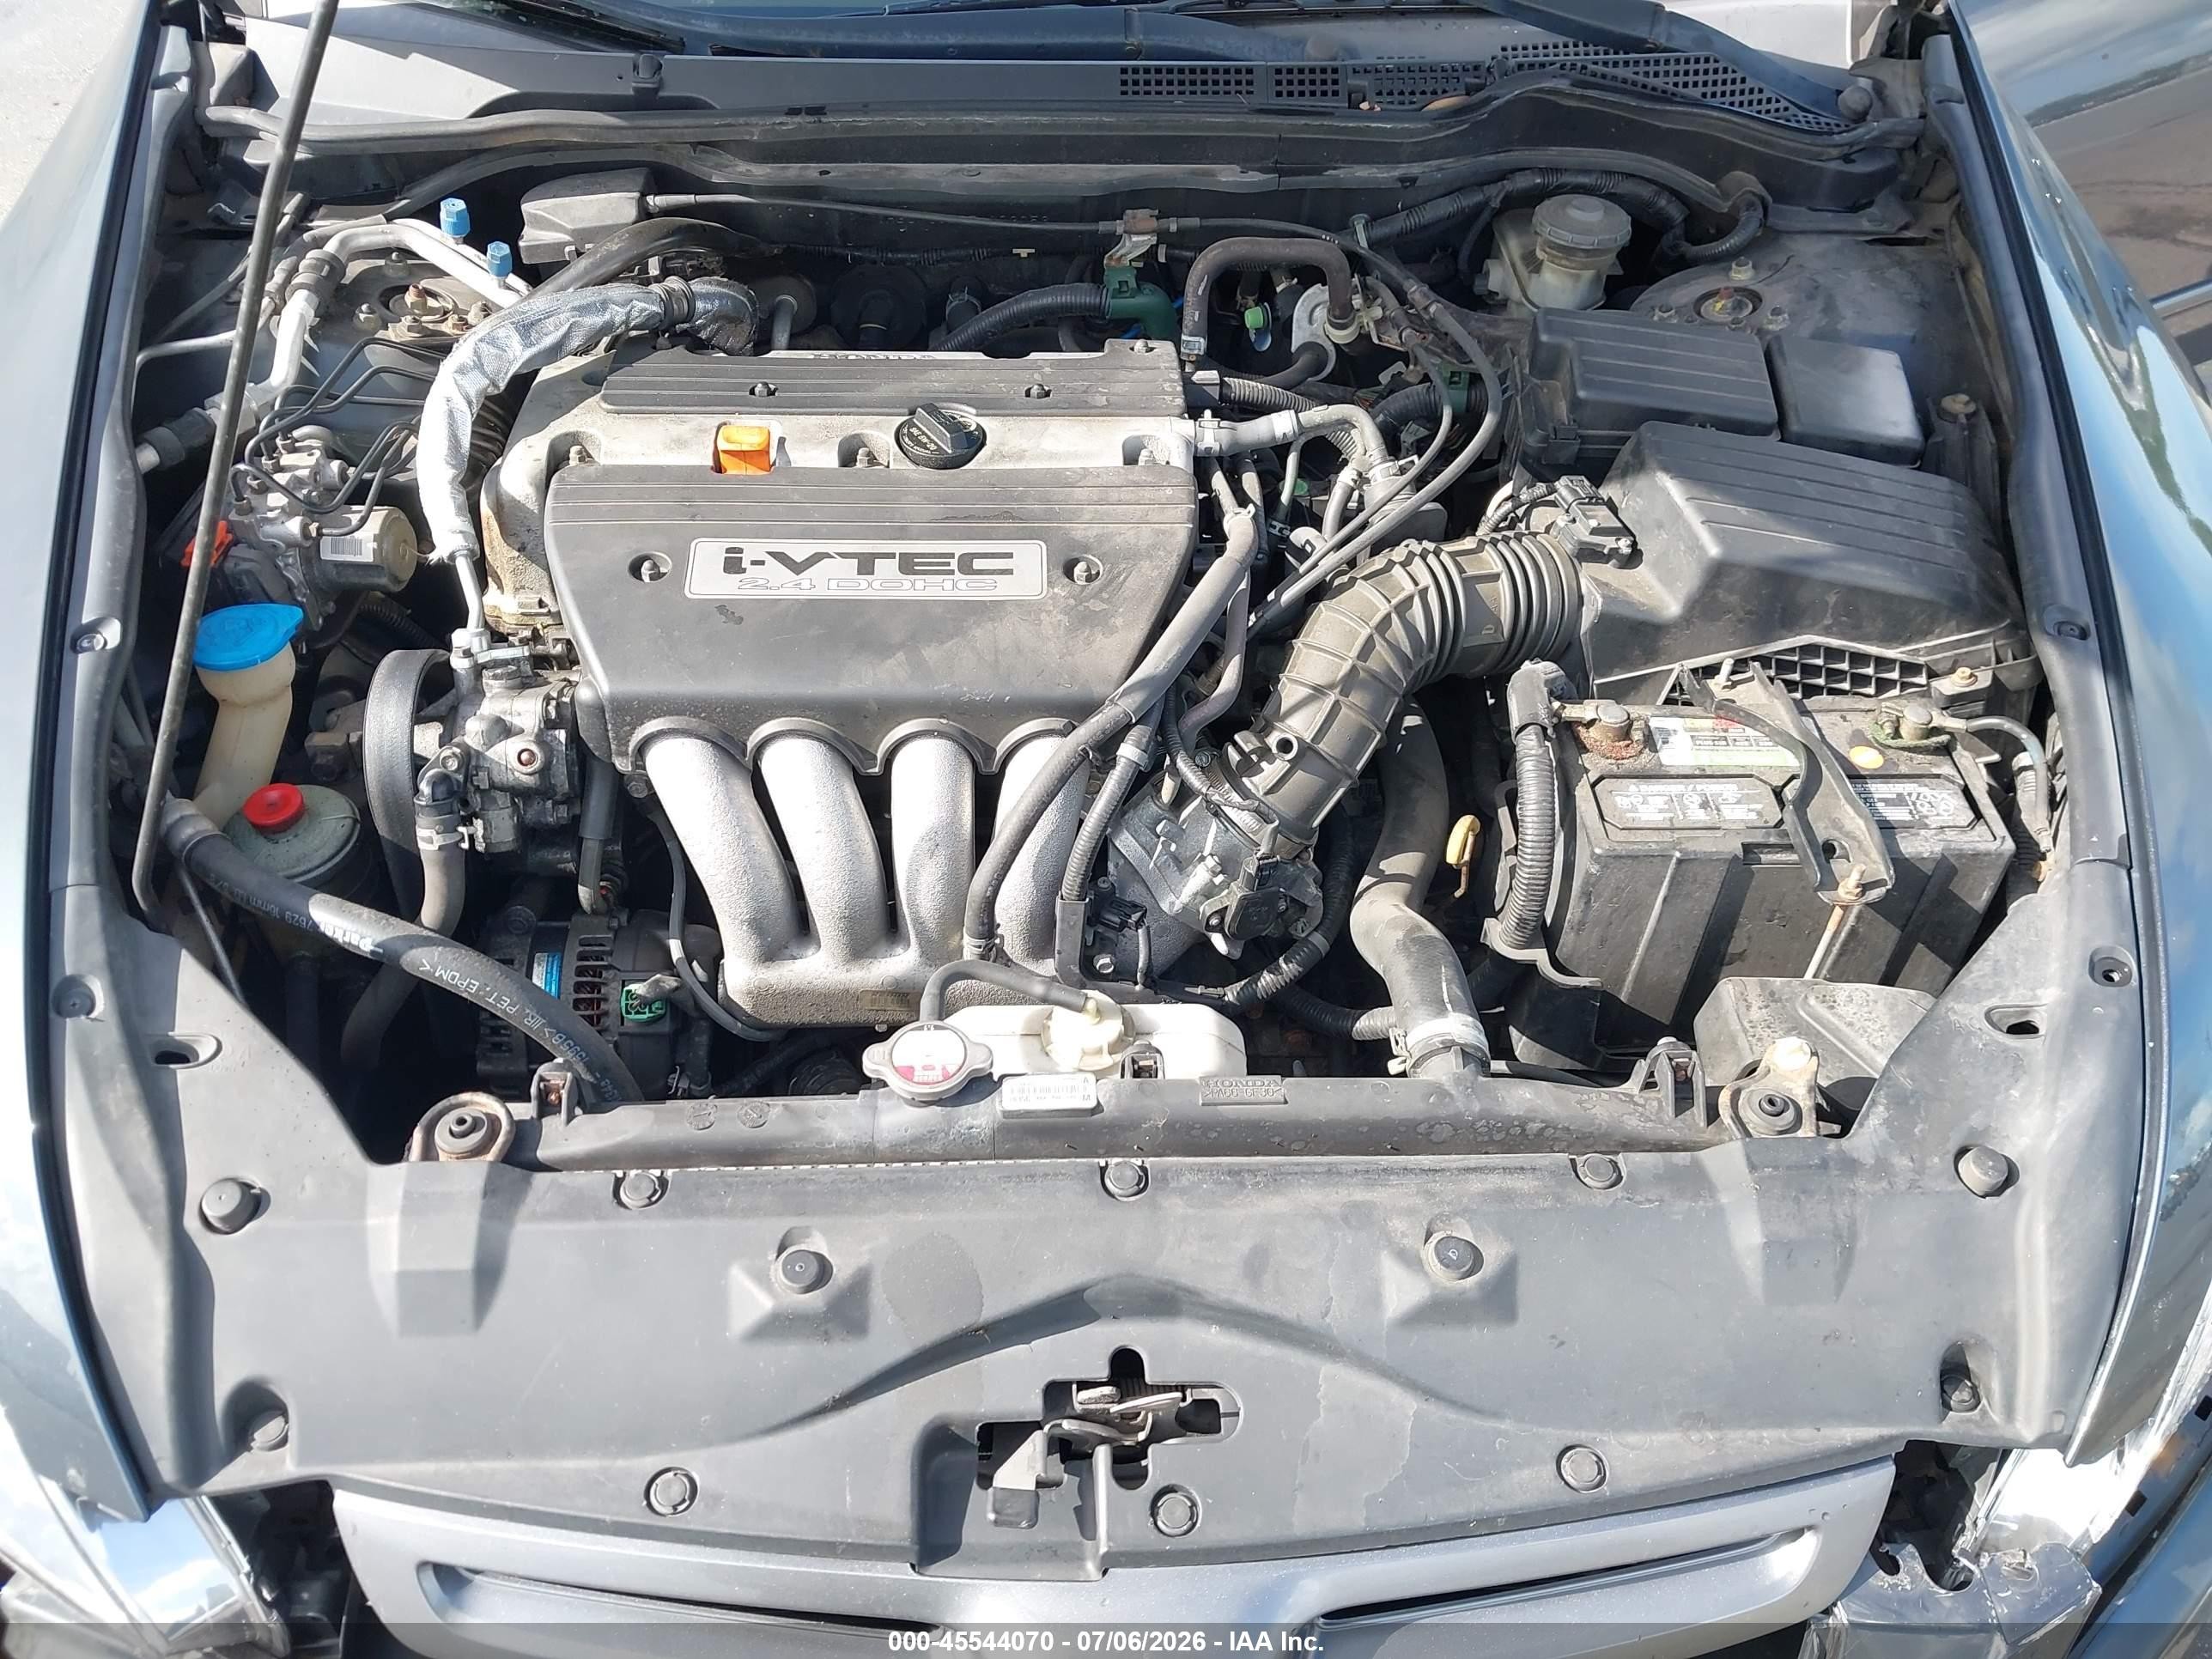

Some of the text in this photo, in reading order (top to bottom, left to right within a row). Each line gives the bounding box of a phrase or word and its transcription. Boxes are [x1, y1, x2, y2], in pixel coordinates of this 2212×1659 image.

[722, 546, 1014, 576] i-VTEC
[737, 577, 998, 592] 2.4 DOHC
[1202, 1078, 1282, 1088] HONDA
